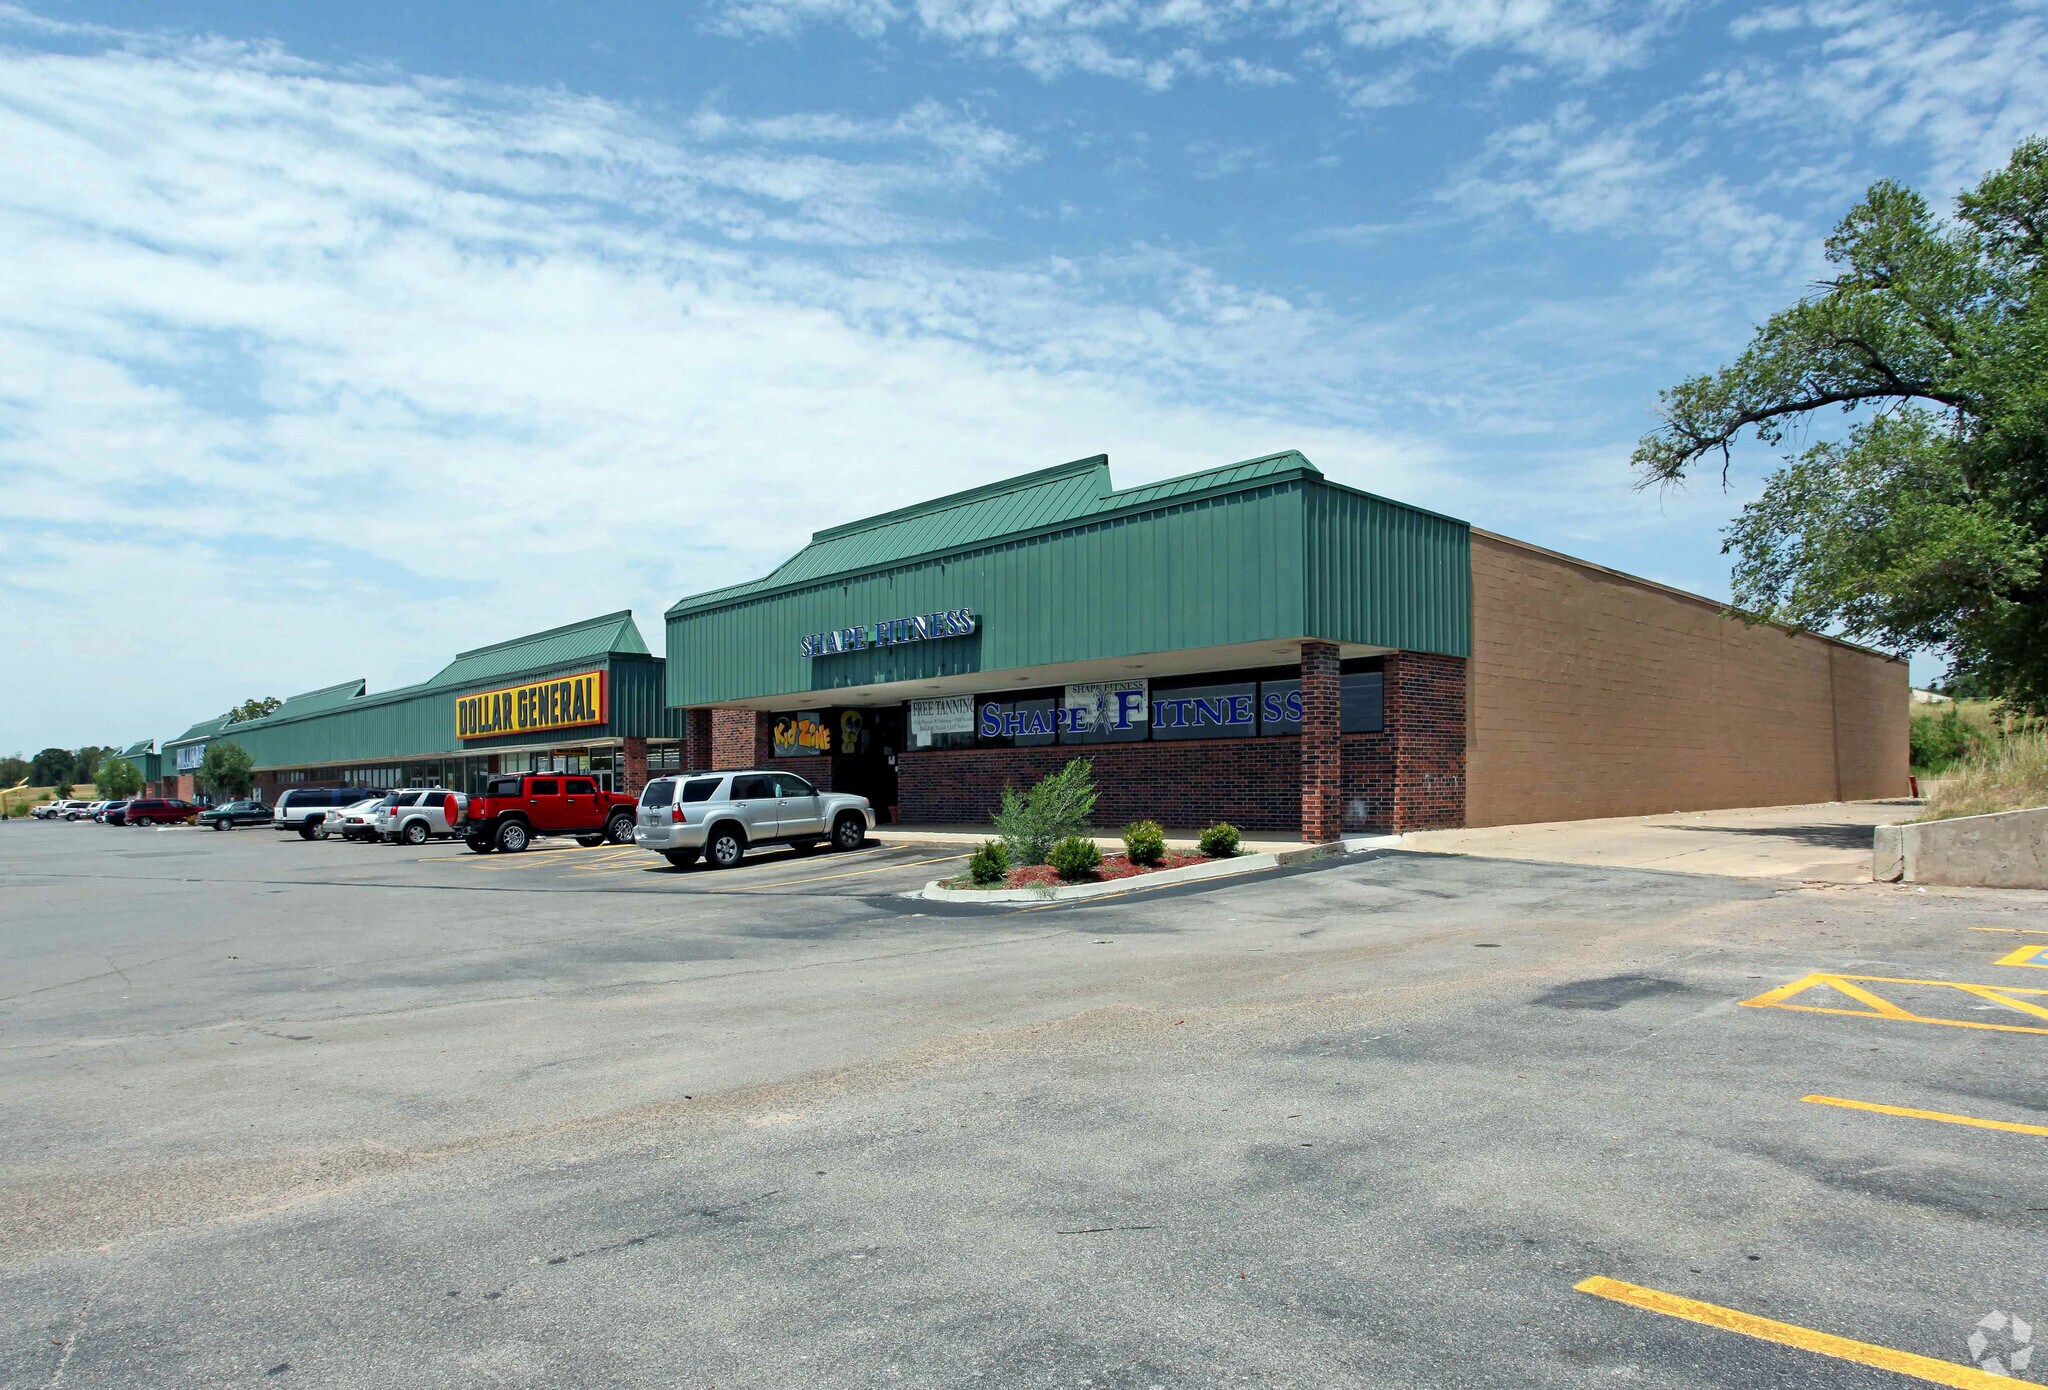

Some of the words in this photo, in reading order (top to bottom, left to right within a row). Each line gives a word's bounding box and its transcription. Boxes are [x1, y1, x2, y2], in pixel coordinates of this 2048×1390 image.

[800, 625, 868, 658] SHAPE
[875, 607, 975, 648] FITNESS
[458, 692, 513, 735] DOLLAR
[517, 677, 596, 728] GENERAL
[912, 701, 934, 717] FREE
[1072, 684, 1102, 693] SHAPE
[1104, 680, 1143, 692] FITNESS
[981, 702, 1090, 738] SHAPE
[1113, 689, 1303, 730] FITNESS
